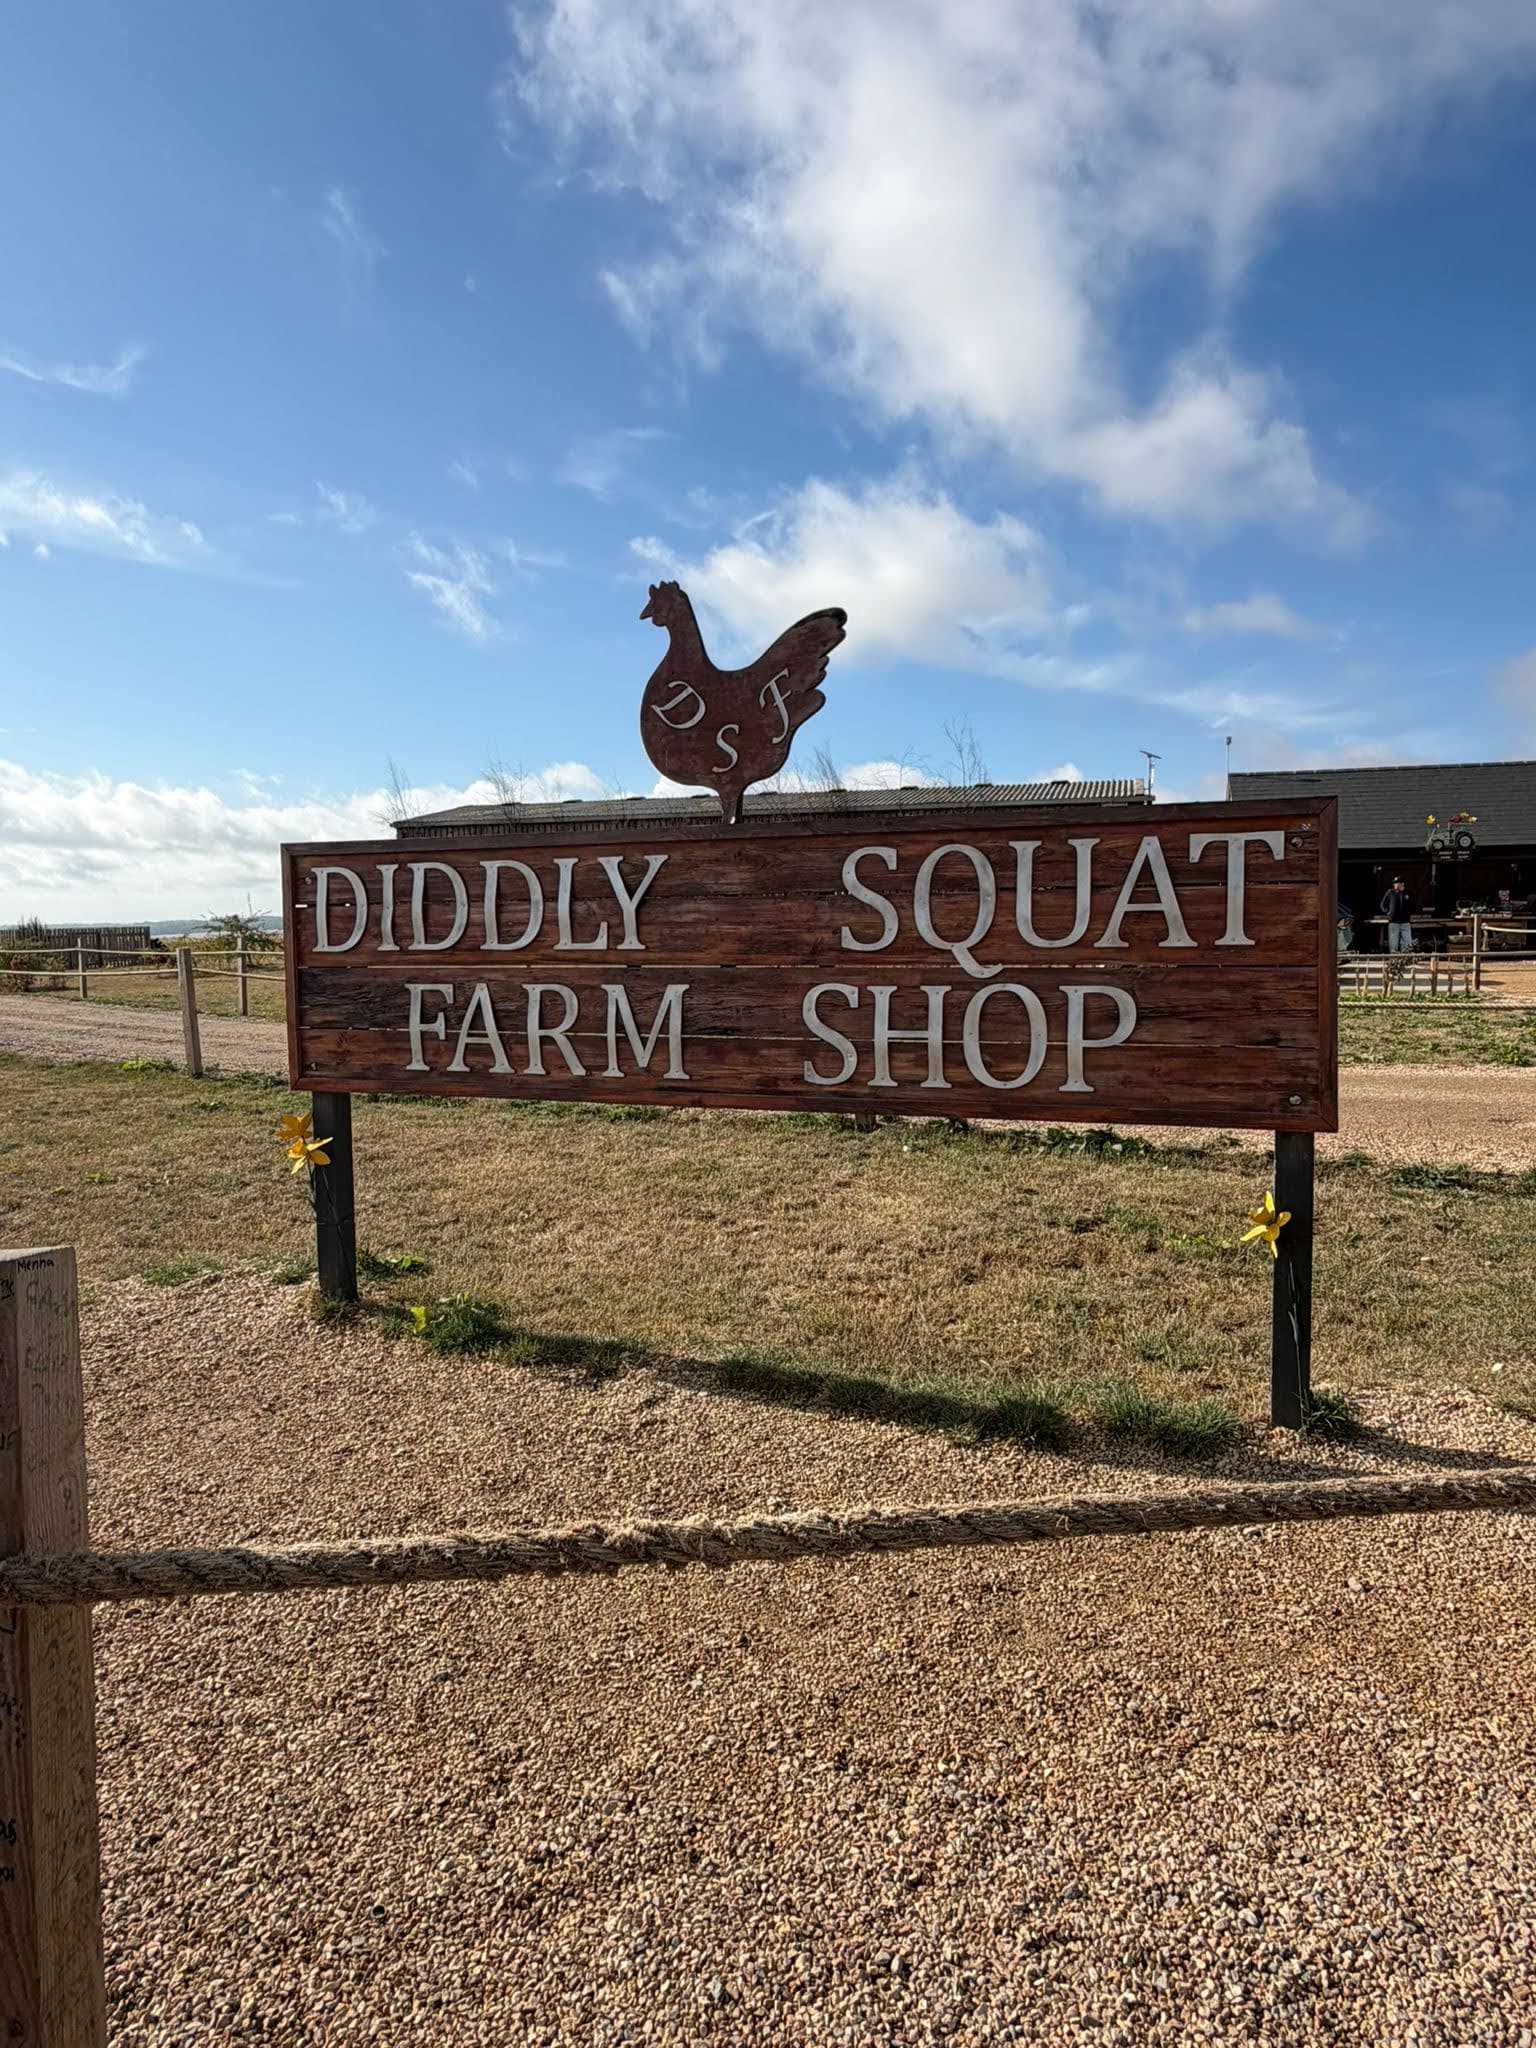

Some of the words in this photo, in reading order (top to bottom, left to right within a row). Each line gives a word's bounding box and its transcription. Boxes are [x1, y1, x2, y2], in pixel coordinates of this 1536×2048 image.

[310, 854, 669, 954] DIDDLY
[840, 830, 1286, 979] SQUAT
[404, 982, 691, 1081] FARM
[801, 983, 1138, 1093] SHOP
